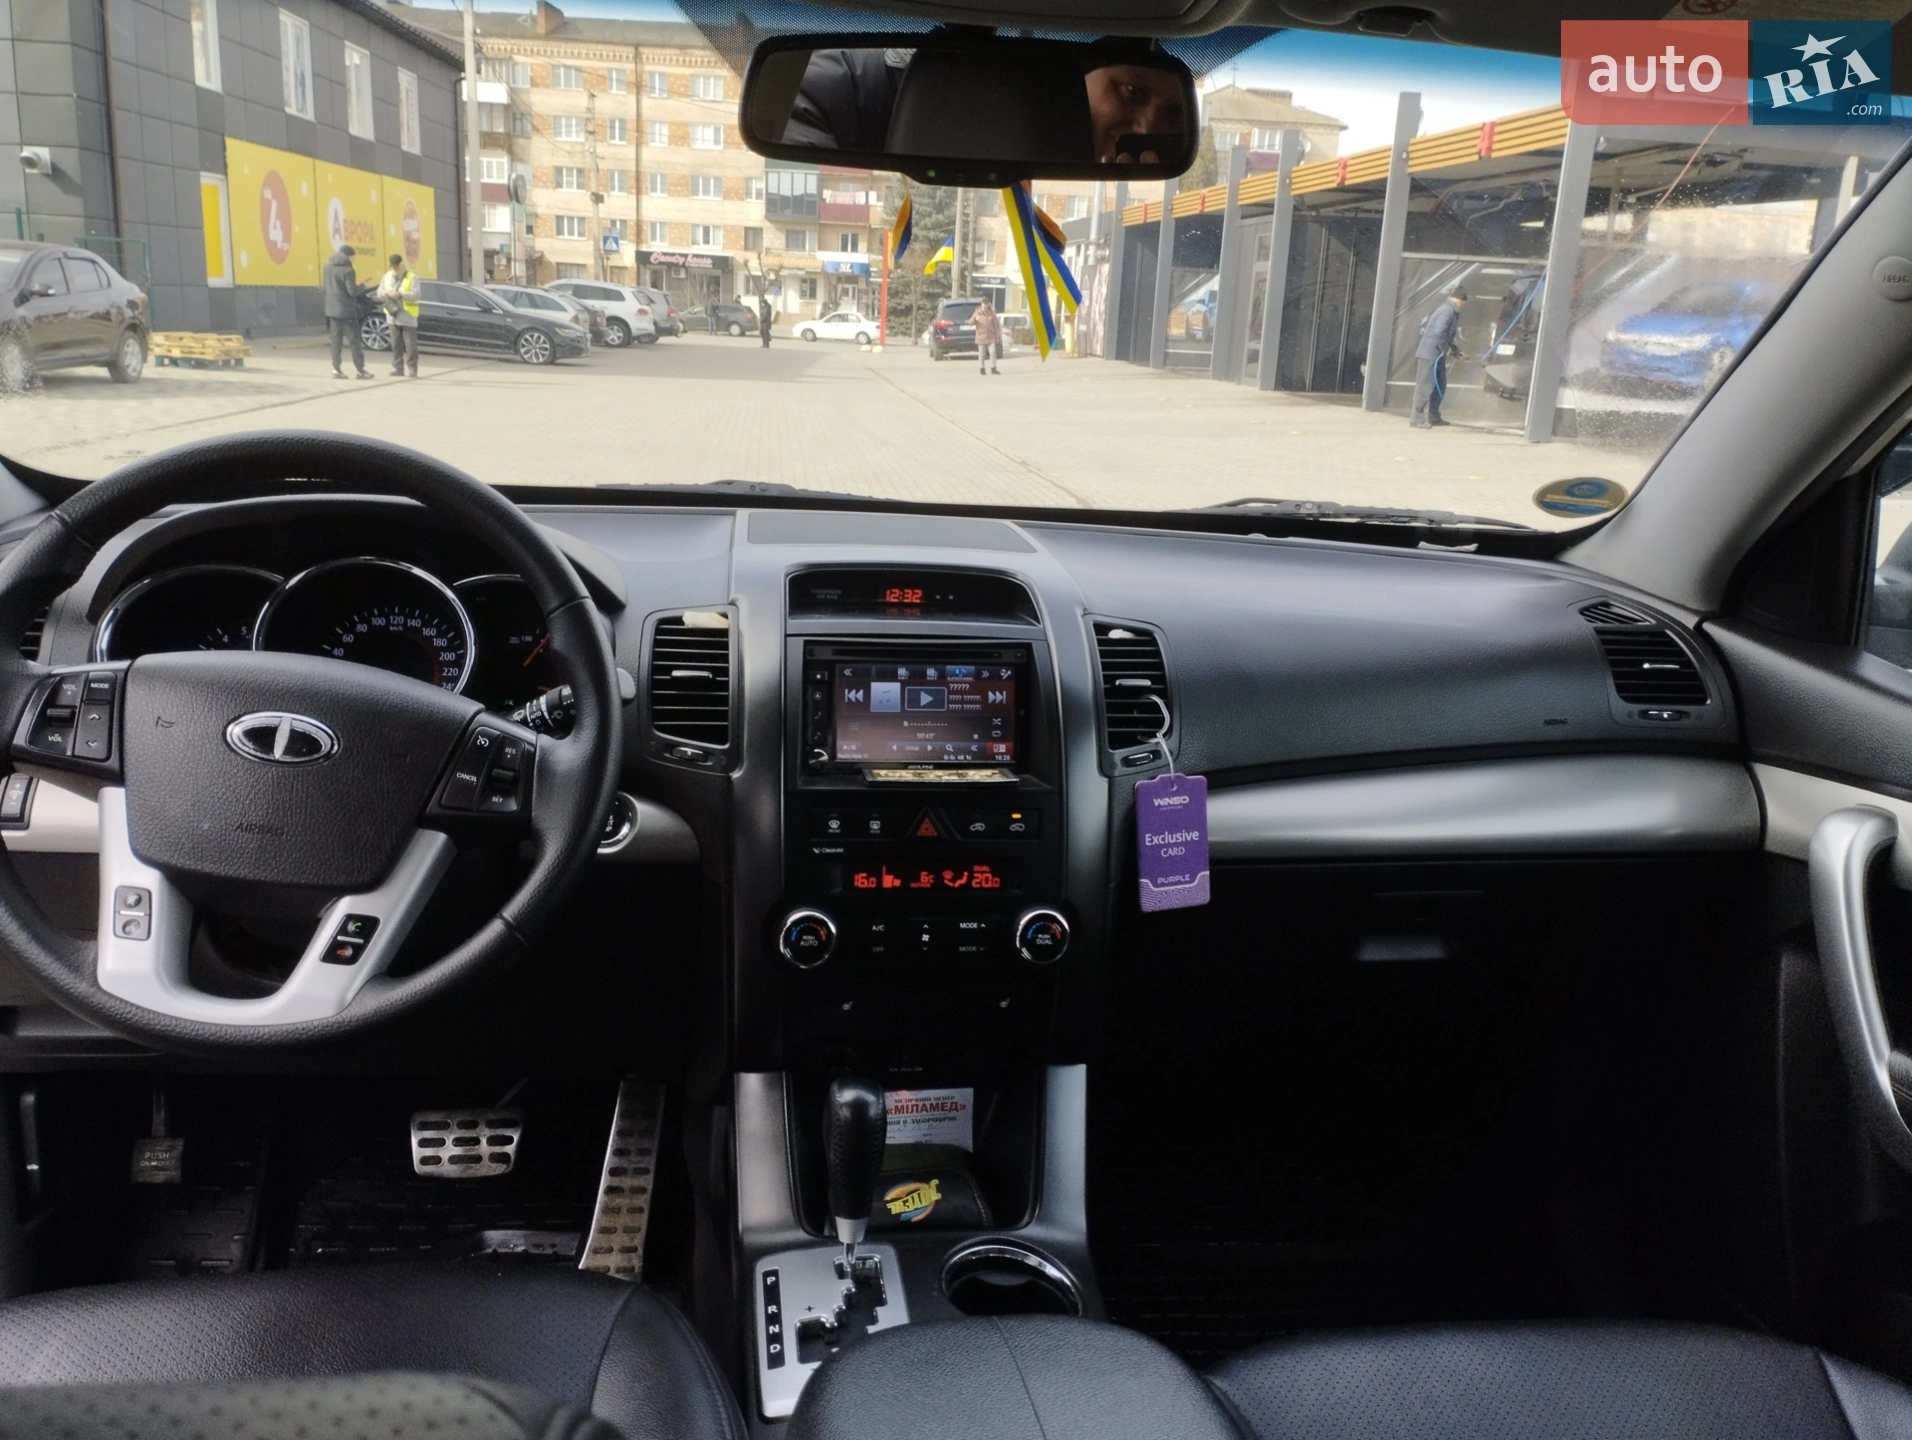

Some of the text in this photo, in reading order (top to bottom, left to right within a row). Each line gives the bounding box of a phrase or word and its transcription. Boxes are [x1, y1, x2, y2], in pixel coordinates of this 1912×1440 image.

[269, 199, 284, 249] 4
[886, 589, 922, 602] 12:32
[371, 616, 386, 626] 100
[389, 616, 404, 625] 120
[406, 618, 421, 628] 140
[241, 626, 248, 635] 5
[356, 623, 368, 633] 80
[422, 627, 436, 637] 160
[222, 634, 229, 643] 4
[342, 634, 354, 644] 60
[433, 637, 447, 647] 180
[332, 647, 344, 657] 40
[439, 652, 455, 662] 200
[442, 667, 459, 677] 220
[63, 683, 77, 691] VOL
[530, 710, 542, 719] AUTO
[48, 735, 63, 743] VOL
[505, 747, 516, 755] RES
[456, 772, 478, 782] CANCEL
[1145, 830, 1200, 846] Exclusive
[1161, 846, 1186, 858] CARD
[1157, 874, 1190, 885] PURPLE
[872, 924, 885, 932] A/C
[887, 1101, 967, 1116] «МІЛАМЕД»
[144, 1151, 170, 1160] PUSH
[766, 1276, 776, 1285] P
[767, 1305, 778, 1314] R
[769, 1324, 780, 1334] N
[770, 1344, 781, 1353] D
